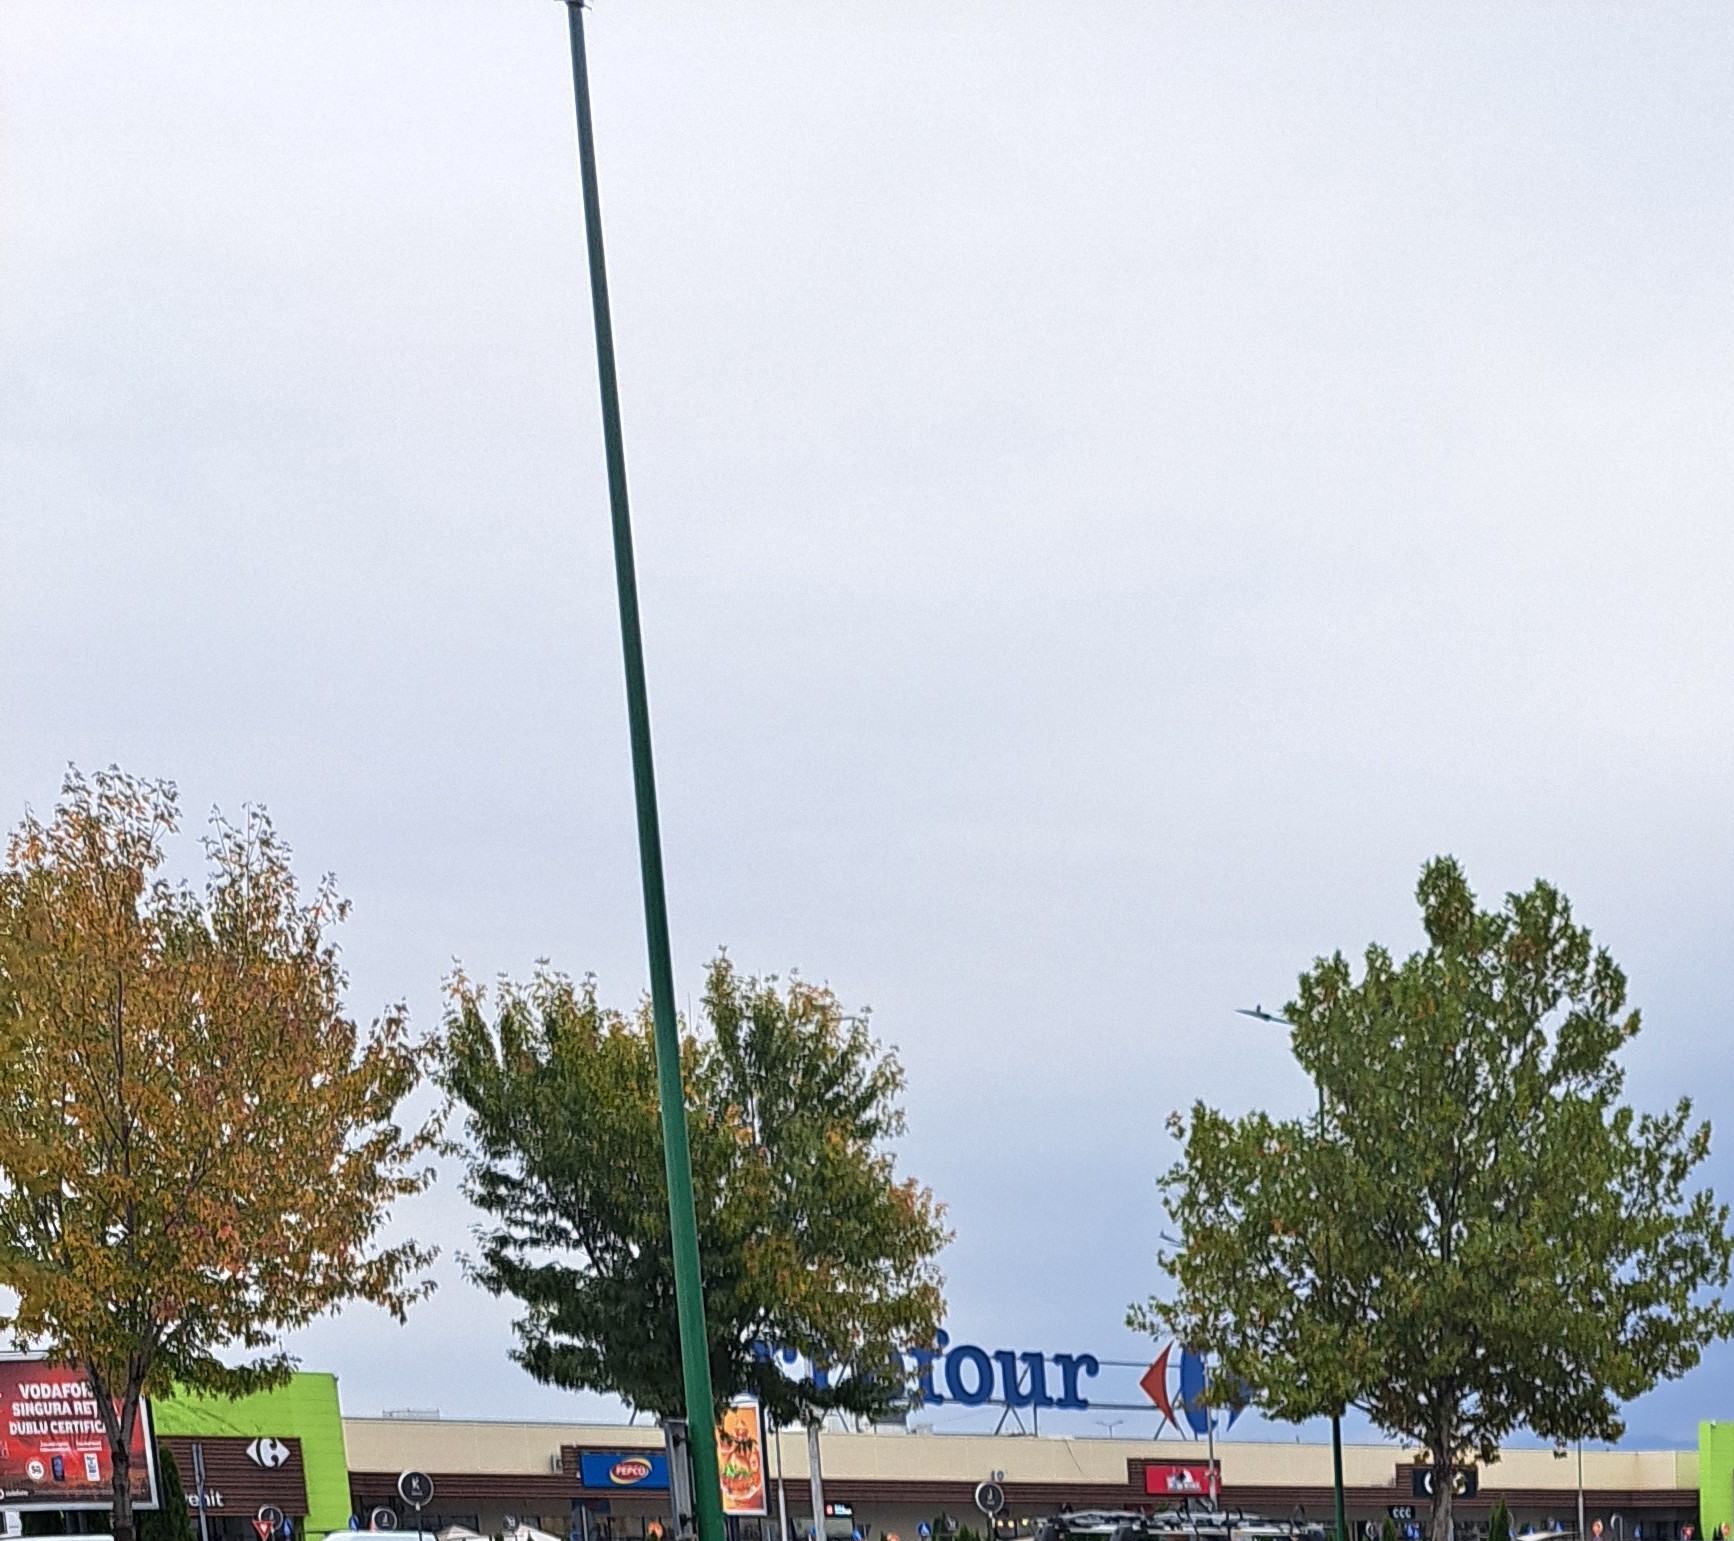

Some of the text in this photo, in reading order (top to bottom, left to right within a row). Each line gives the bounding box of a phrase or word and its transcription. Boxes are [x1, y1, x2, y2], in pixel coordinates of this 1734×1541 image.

[12, 1400, 73, 1417] SINGURA
[9, 1420, 48, 1436] DUBLU
[615, 1463, 646, 1476] PEPCO
